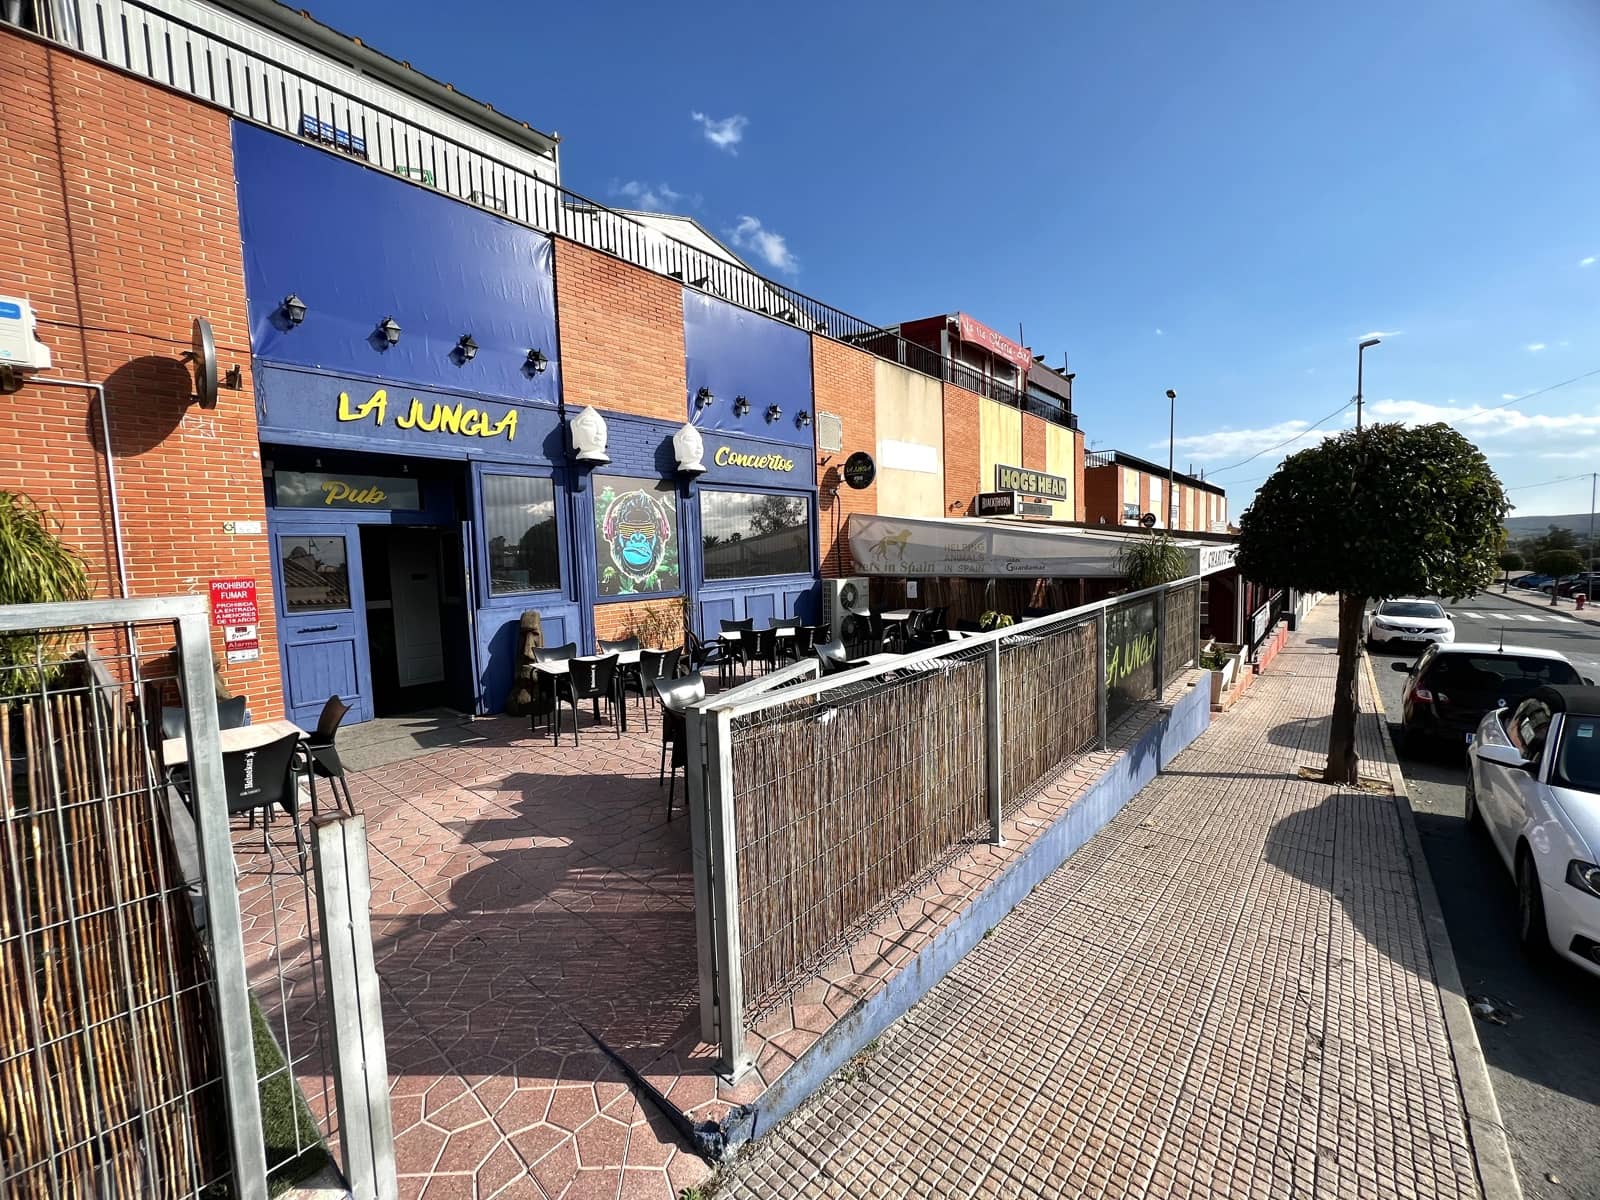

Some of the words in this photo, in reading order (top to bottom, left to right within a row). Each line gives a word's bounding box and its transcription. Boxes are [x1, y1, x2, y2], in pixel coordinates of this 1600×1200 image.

[337, 389, 388, 426] LA
[396, 397, 518, 441] JUNGLA
[714, 446, 795, 473] Conciertos
[1000, 468, 1036, 492] HOG'S
[1038, 475, 1066, 496] HEAD
[321, 480, 387, 505] Pub
[944, 543, 985, 553] HELPING
[944, 552, 985, 562] ANIMALS
[884, 561, 896, 572] in
[900, 560, 936, 574] Spain
[944, 564, 953, 573] IN
[958, 564, 985, 573] SPAIN
[212, 581, 255, 591] PROHIBIDO
[221, 591, 248, 599] FUMAR
[228, 641, 258, 649] Alarma
